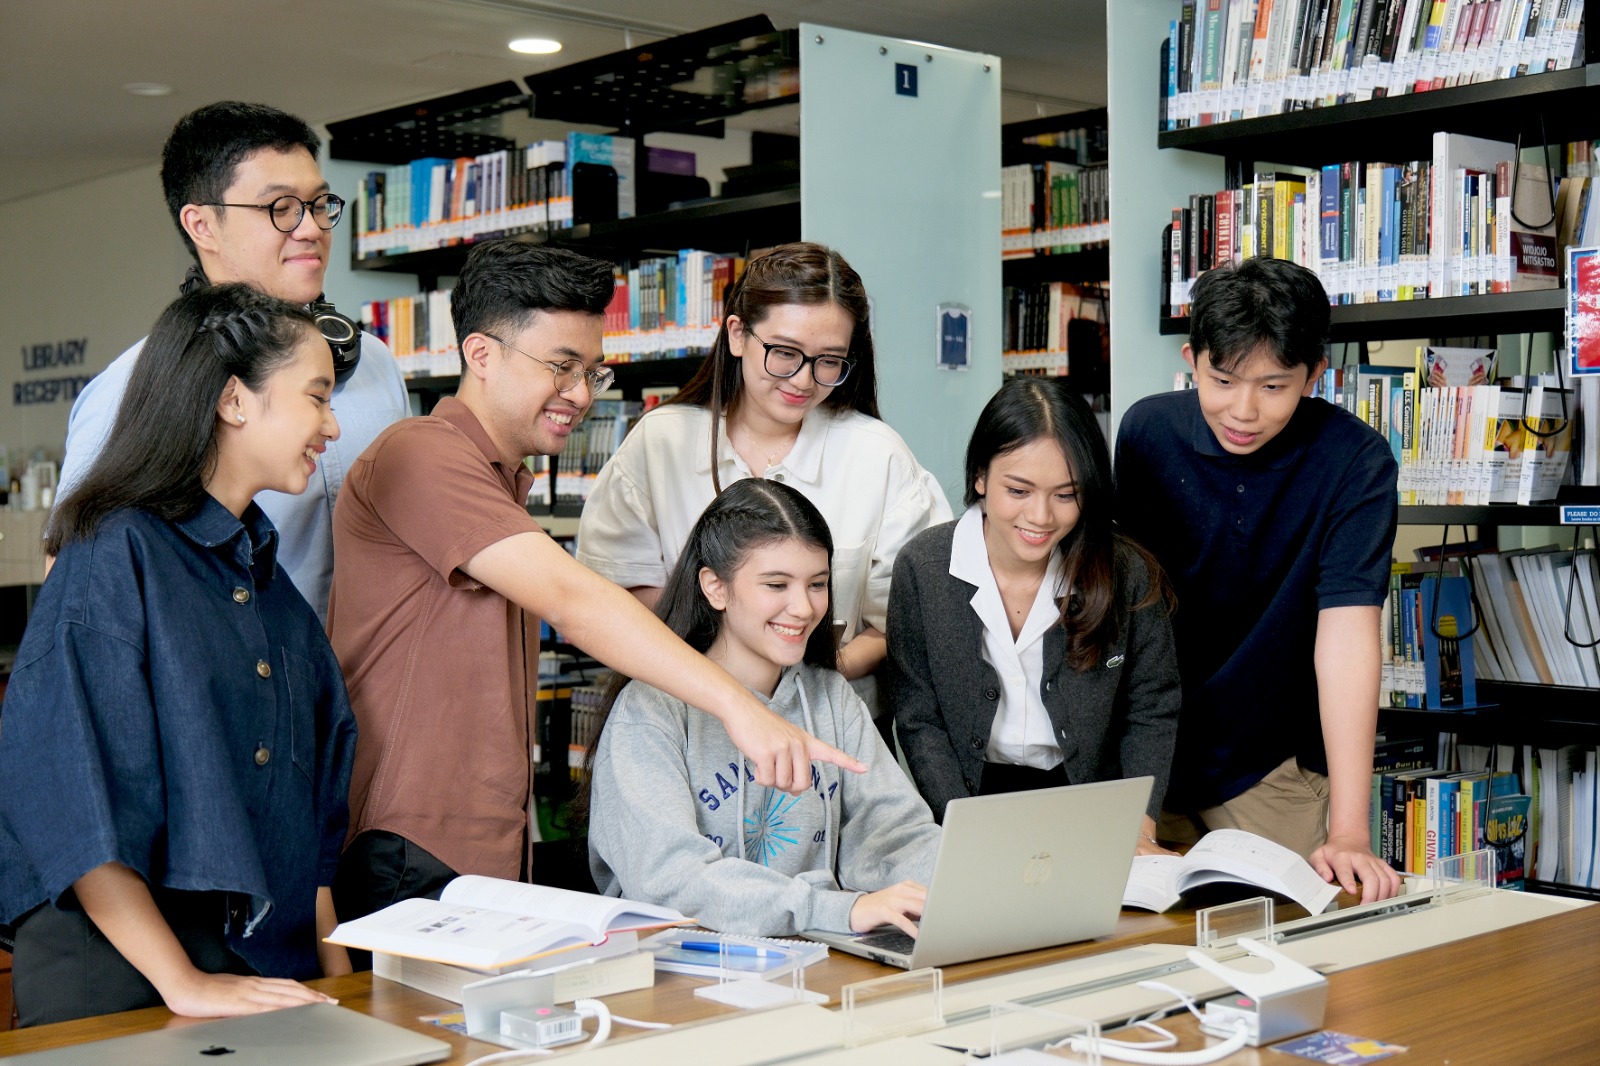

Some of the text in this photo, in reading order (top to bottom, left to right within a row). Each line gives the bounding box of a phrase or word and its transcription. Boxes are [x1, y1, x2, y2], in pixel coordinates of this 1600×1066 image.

[902, 70, 910, 89] 1
[1217, 212, 1230, 263] CHINA FOR
[1522, 244, 1547, 256] WIDJOJO
[1522, 255, 1555, 268] NITISASTRO
[21, 337, 88, 371] LIBRARY
[14, 375, 91, 406] RECEPTIO
[1403, 405, 1411, 448] Constitution
[699, 762, 755, 811] SAN
[1426, 830, 1436, 869] GIVING
